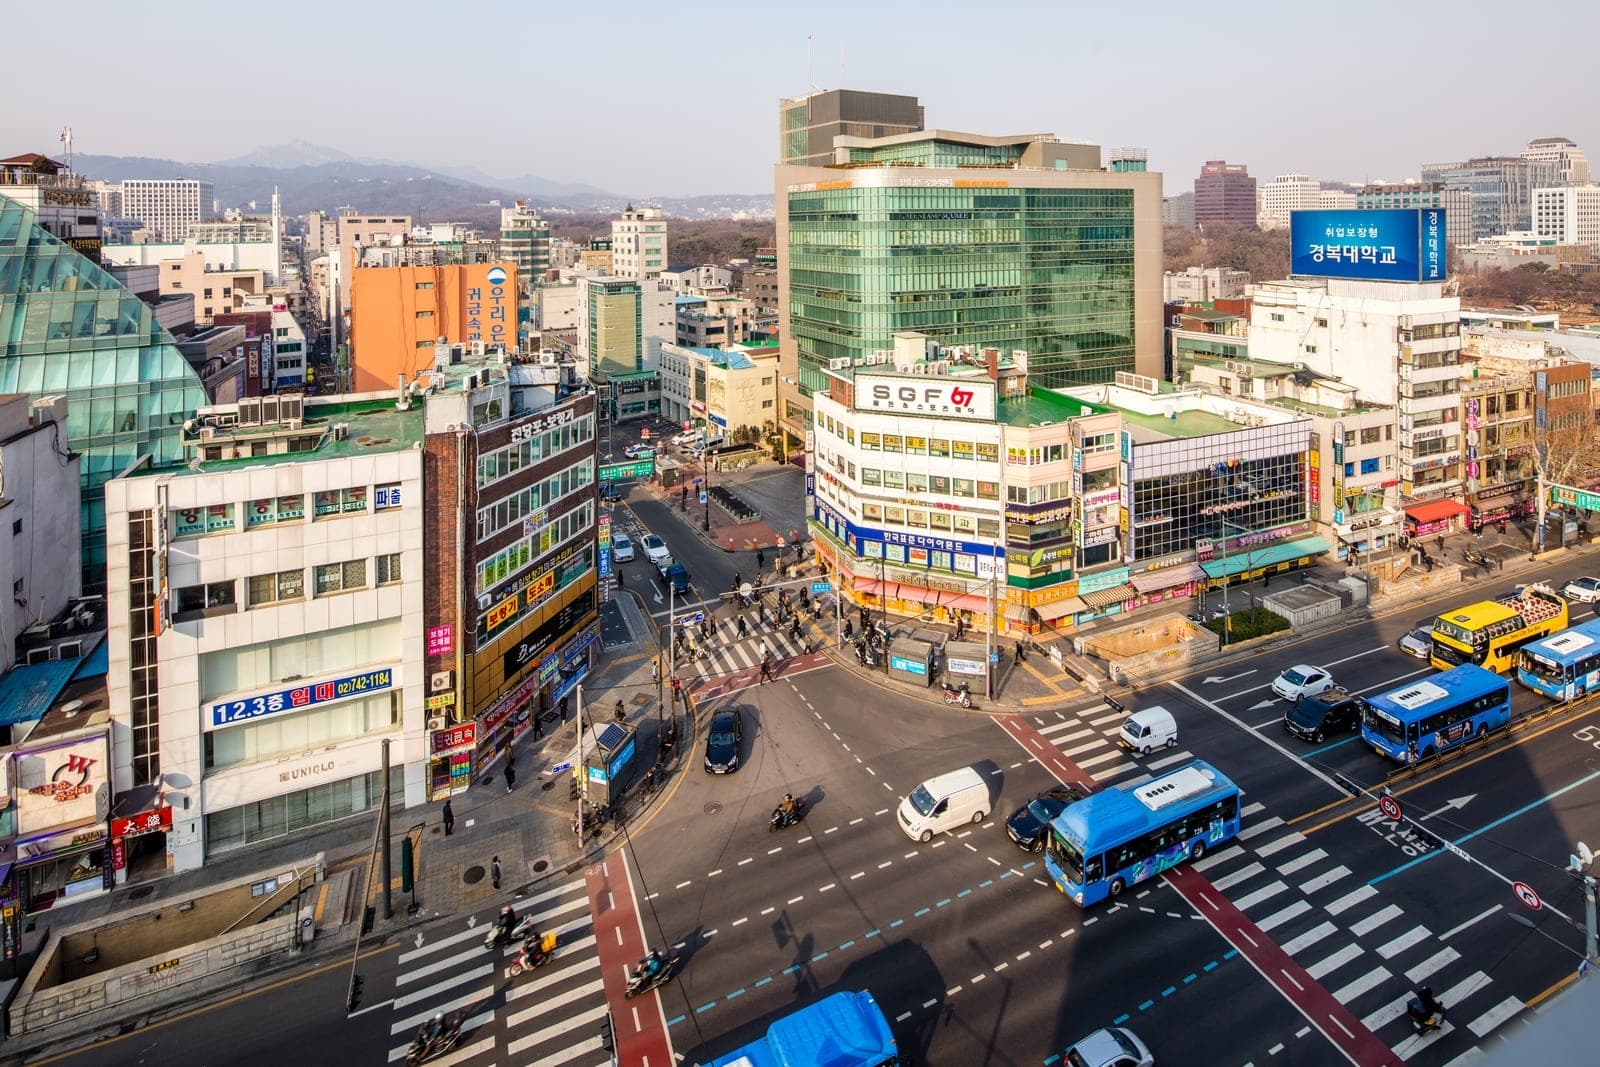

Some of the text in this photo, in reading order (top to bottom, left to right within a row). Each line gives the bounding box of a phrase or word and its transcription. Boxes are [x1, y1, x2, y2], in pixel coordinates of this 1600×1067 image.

[1325, 226, 1378, 239] 취업보장형
[1309, 244, 1398, 265] 경복대학교
[1428, 211, 1439, 278] 경복대학교
[376, 488, 401, 505] 파출
[489, 599, 517, 628] 보청기
[337, 671, 390, 695] 02)742-1184
[68, 754, 97, 775] W
[291, 761, 336, 780] UNIQLO
[1384, 801, 1397, 815] 50
